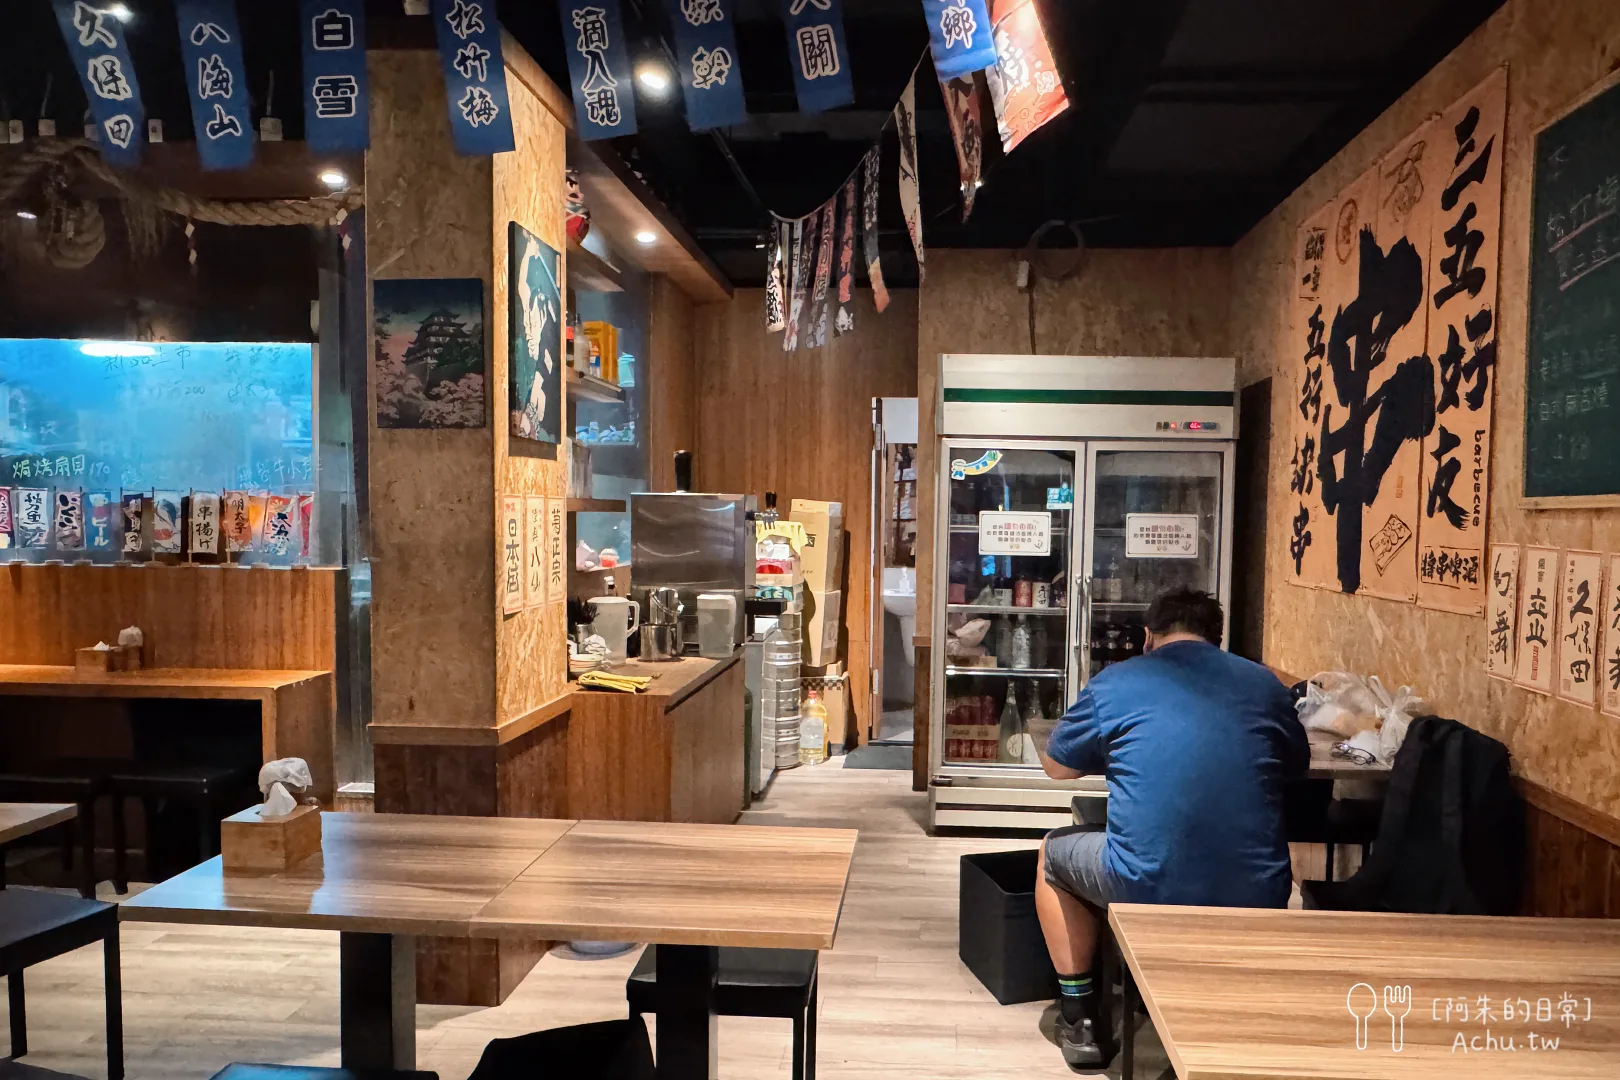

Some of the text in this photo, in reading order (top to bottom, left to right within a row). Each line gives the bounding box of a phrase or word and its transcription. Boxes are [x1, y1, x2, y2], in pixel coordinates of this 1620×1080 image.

[73, 0, 135, 149] 久保田
[189, 21, 243, 140] 八海山
[312, 8, 359, 119] 白雪
[446, 0, 499, 128] 松竹梅
[1427, 106, 1497, 531] 三五好友
[12, 455, 85, 479] 焗烤扇貝
[232, 499, 247, 534] 明太子
[1473, 429, 1486, 528] barbecue
[195, 504, 214, 550] 串揚げ
[1525, 587, 1549, 649] 立山
[1563, 579, 1594, 684] 久保田
